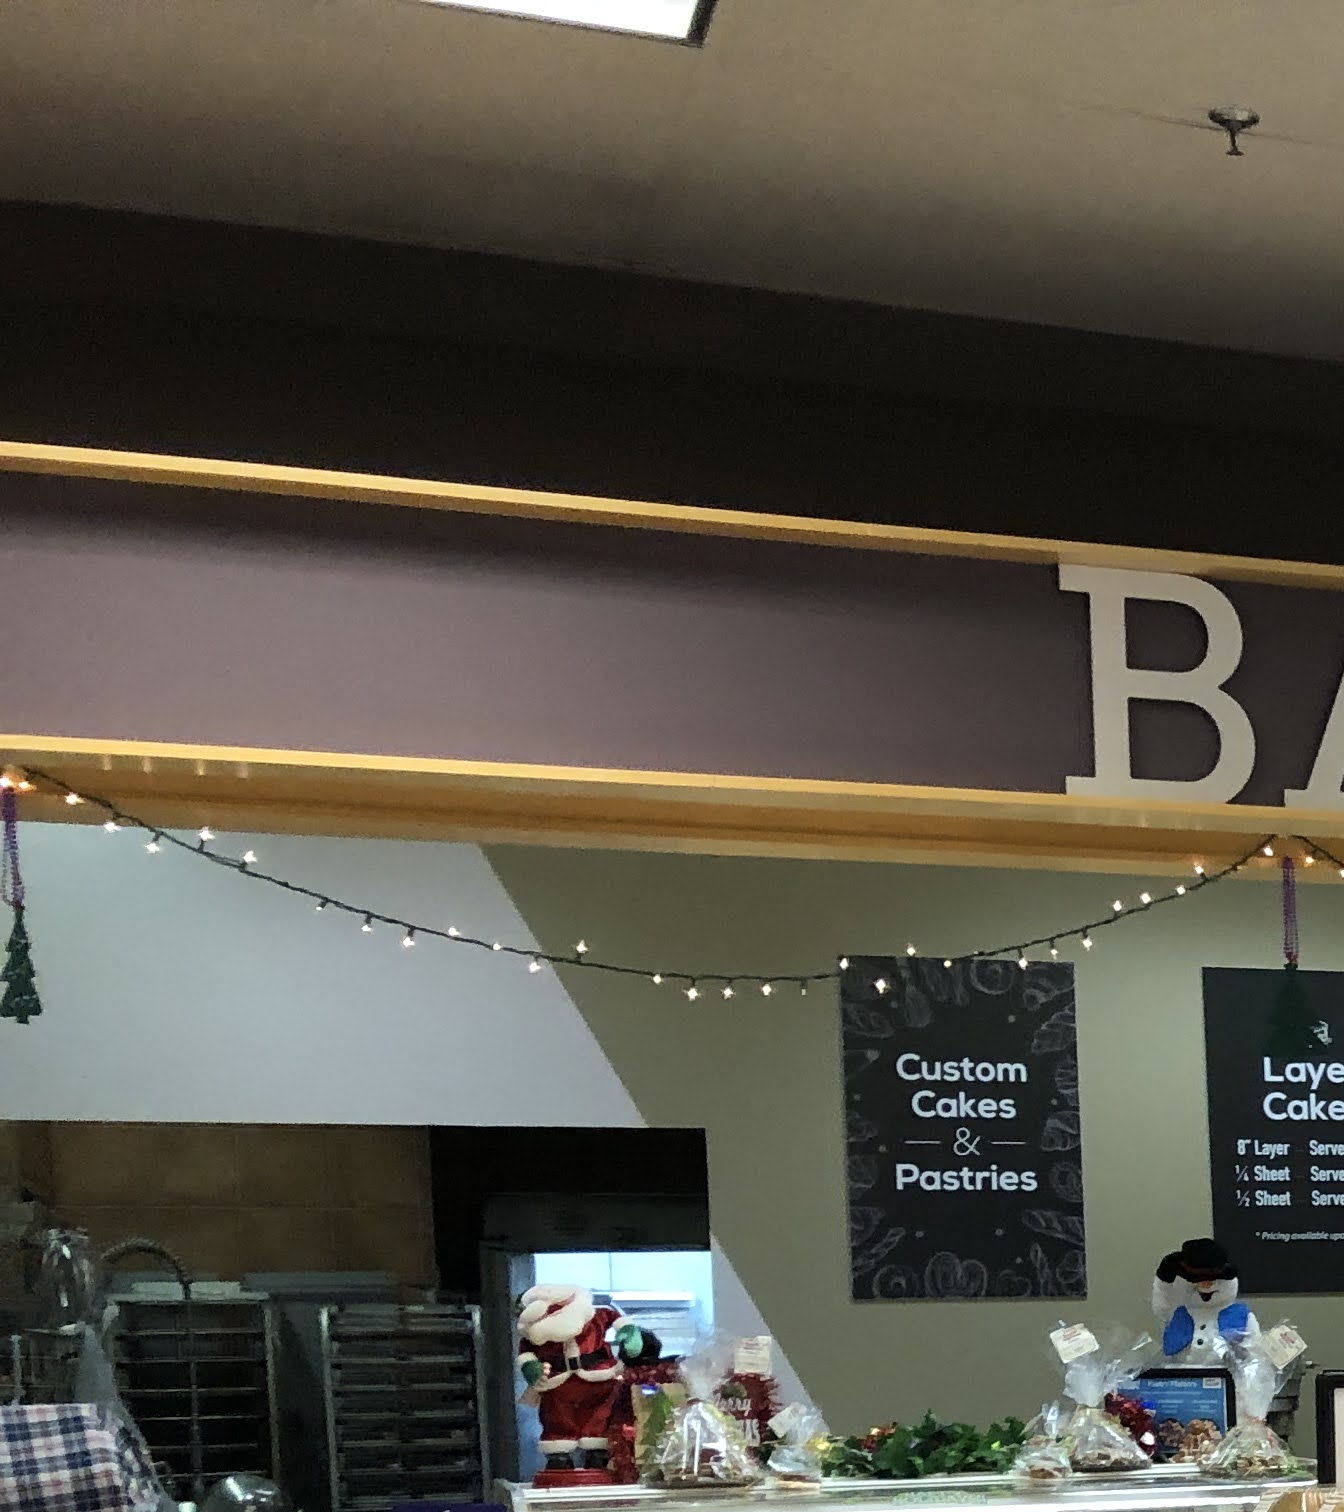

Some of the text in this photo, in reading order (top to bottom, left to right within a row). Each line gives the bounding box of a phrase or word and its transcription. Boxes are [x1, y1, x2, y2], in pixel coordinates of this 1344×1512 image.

[895, 1053, 1028, 1084] Custom
[911, 1089, 1018, 1121] Cakes
[952, 1127, 981, 1157] &
[1254, 1139, 1291, 1160] Layer
[895, 1162, 1038, 1192] Pastries
[1254, 1165, 1291, 1182] Sheet
[1255, 1189, 1292, 1206] Sheet
